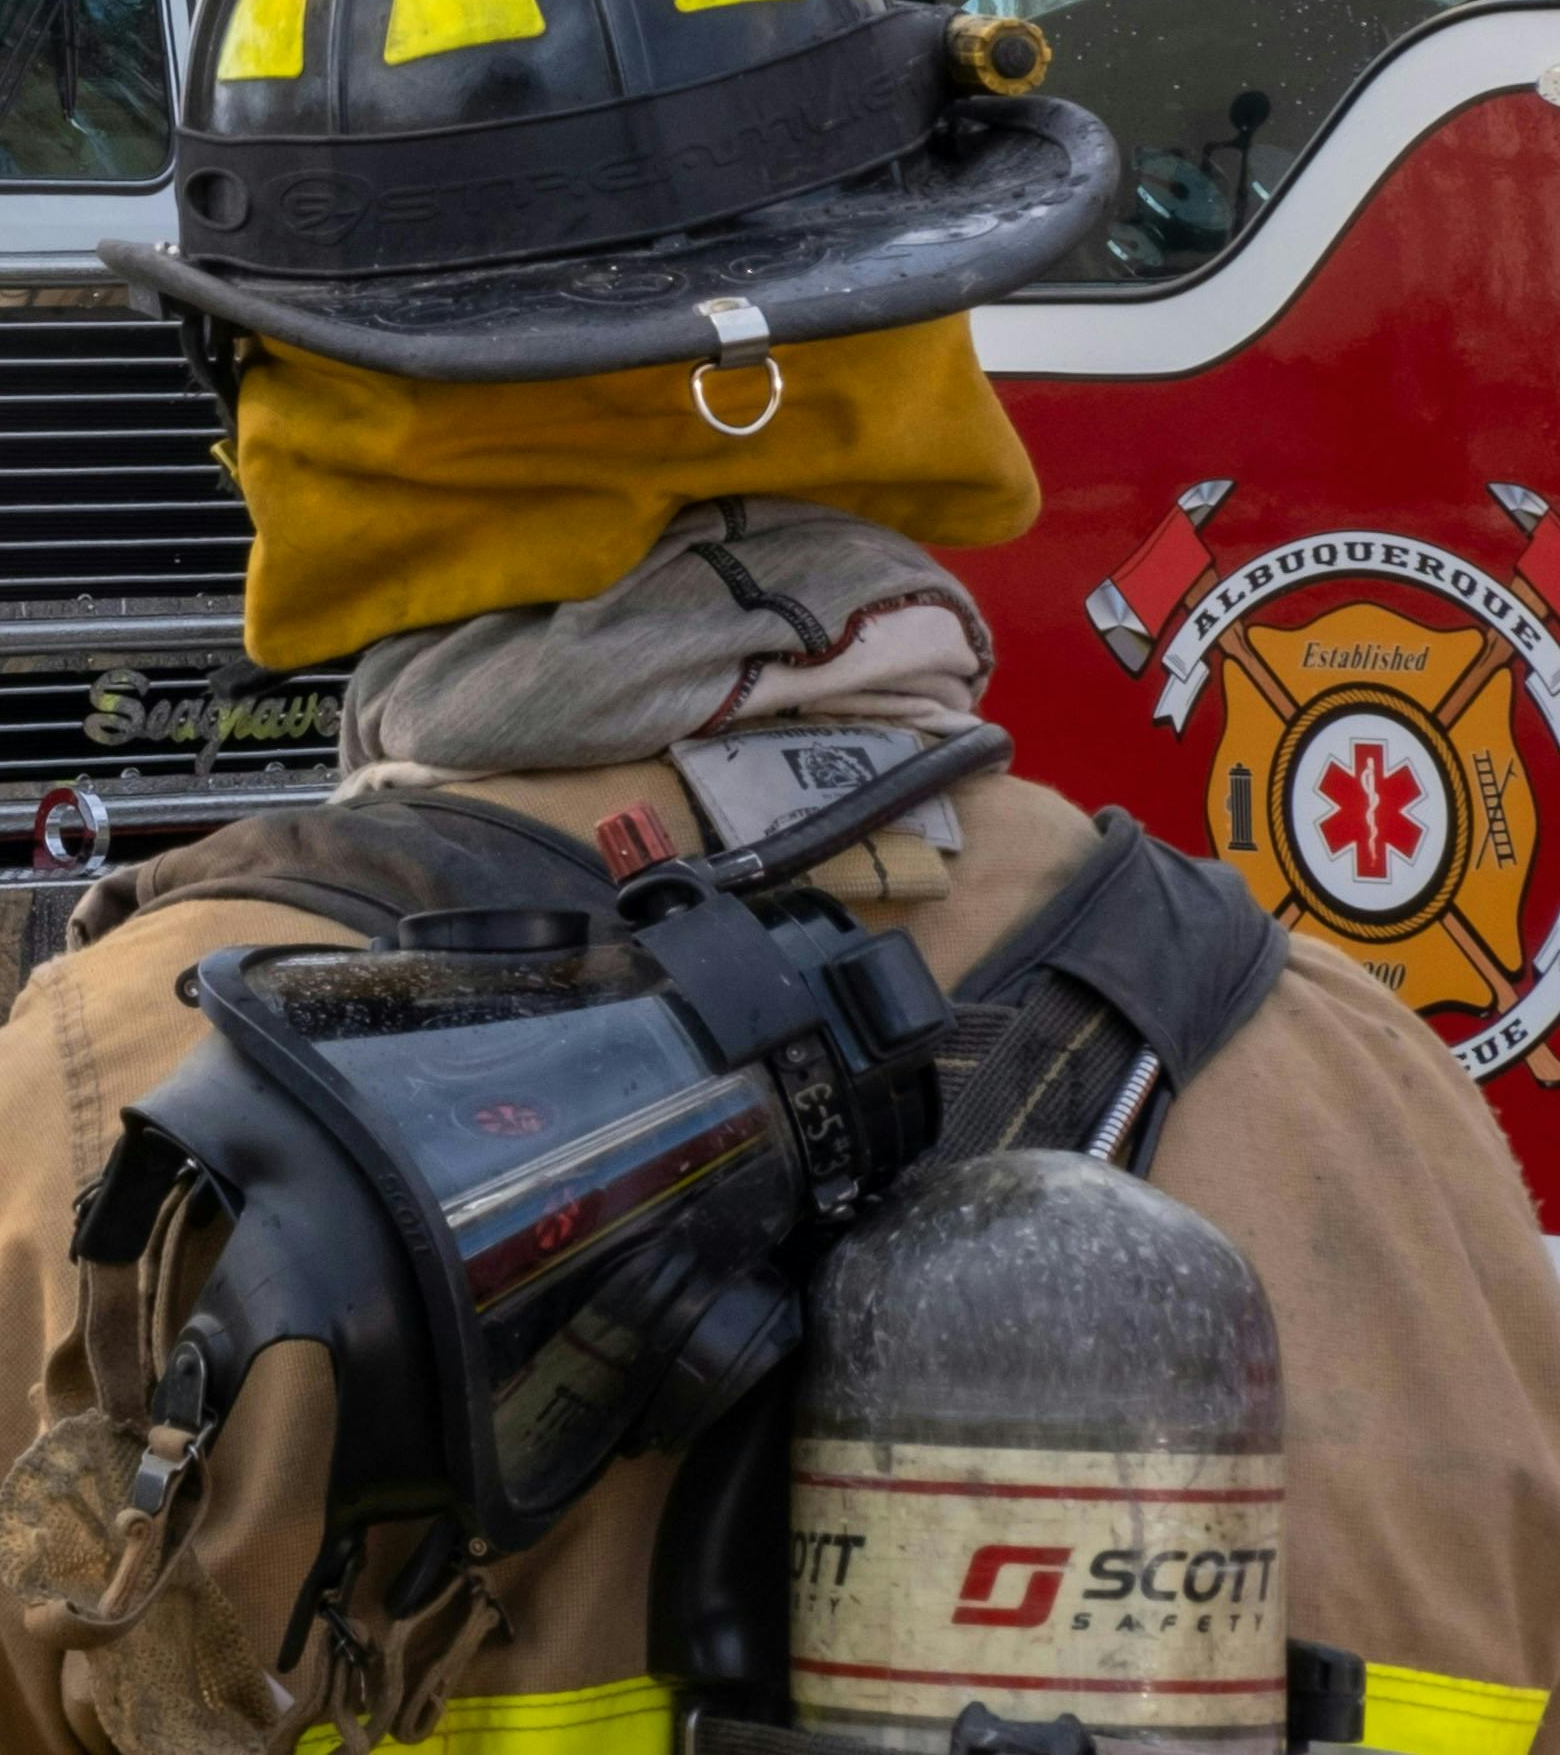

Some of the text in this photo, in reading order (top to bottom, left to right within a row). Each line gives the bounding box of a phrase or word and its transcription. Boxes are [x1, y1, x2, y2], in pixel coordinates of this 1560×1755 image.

[1194, 541, 1542, 652] ALBUQUERQUE
[1301, 641, 1430, 672] Established
[83, 668, 341, 776] Seagrave
[1362, 961, 1406, 991] 00
[791, 1531, 867, 1587] OTT
[1082, 1547, 1278, 1604] SCOTT
[1071, 1611, 1265, 1634] SAFETY
